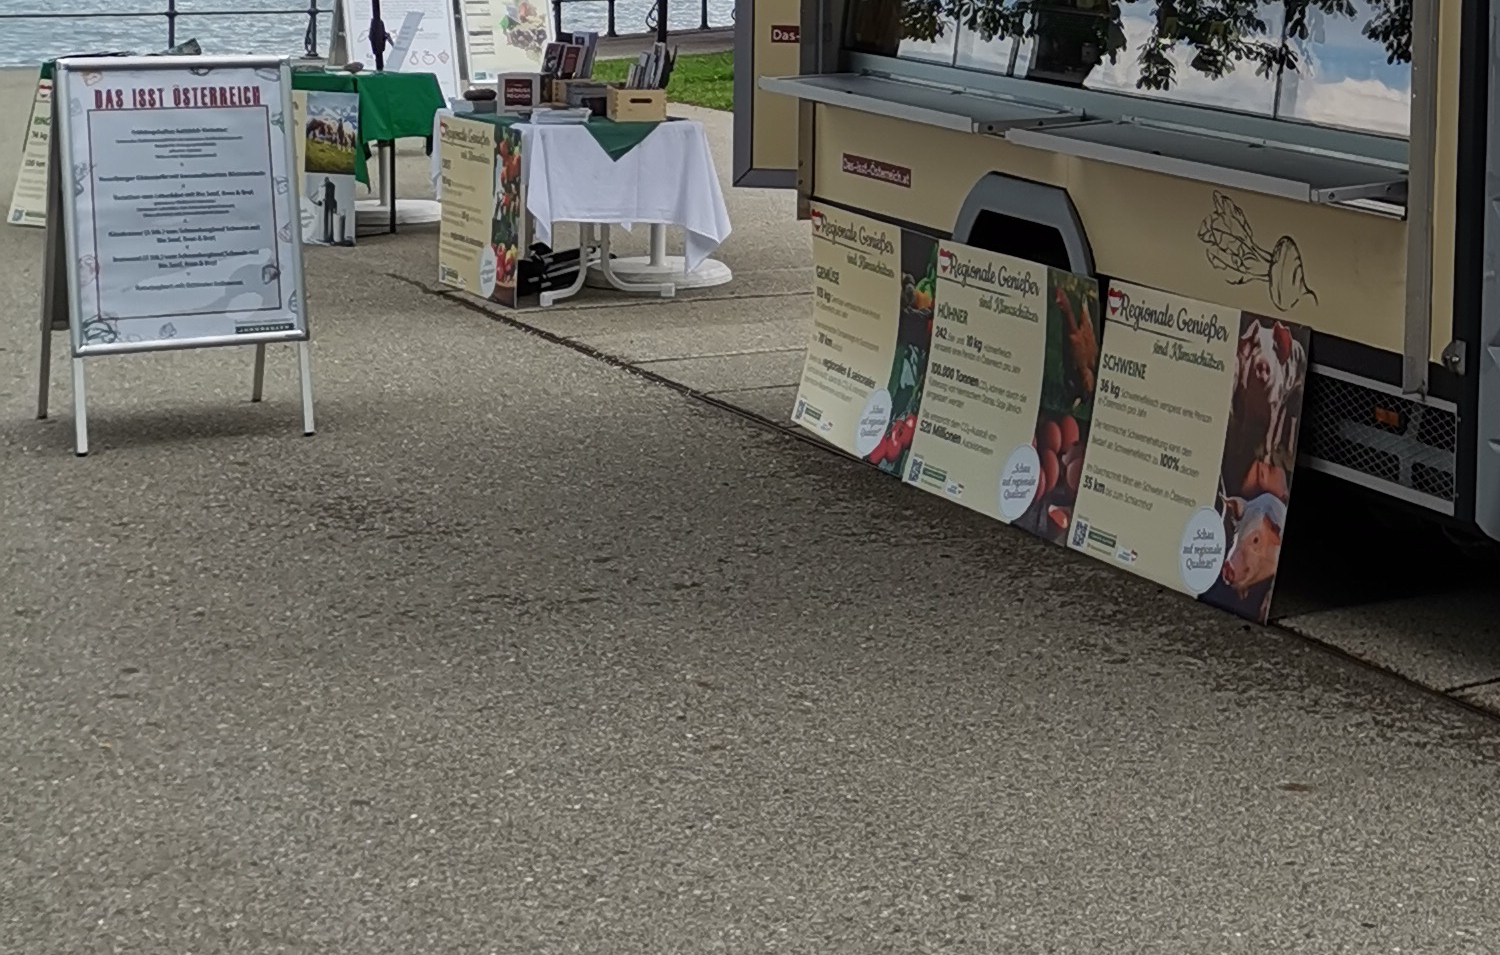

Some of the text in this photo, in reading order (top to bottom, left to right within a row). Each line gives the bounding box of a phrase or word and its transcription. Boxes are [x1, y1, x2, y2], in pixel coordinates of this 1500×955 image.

[94, 84, 262, 110] DAS ISST ÖSTERREICH
[949, 253, 1041, 299] Regionale Genießer
[937, 301, 969, 325] HÜHNER
[1119, 293, 1231, 344] Regionale Genießer
[955, 368, 980, 388] Tonnen
[1102, 352, 1148, 380] SCHWEINE
[1109, 380, 1121, 400] kg
[1159, 452, 1181, 472] 100%
[1092, 477, 1106, 495] km
